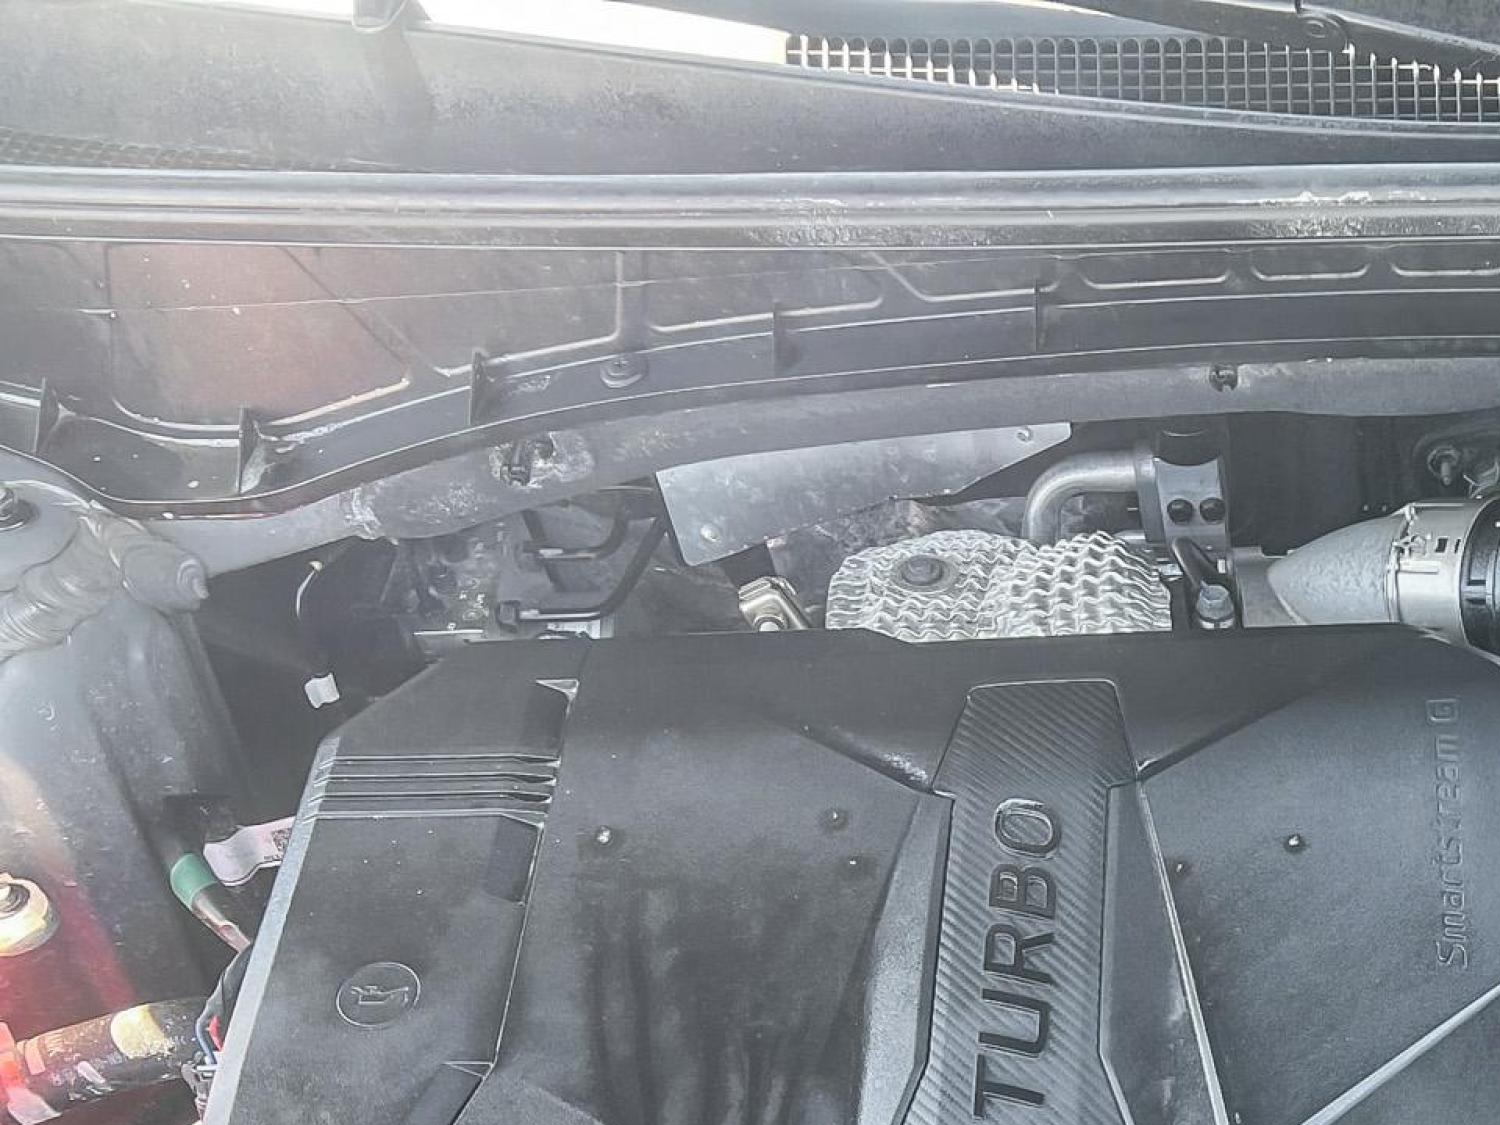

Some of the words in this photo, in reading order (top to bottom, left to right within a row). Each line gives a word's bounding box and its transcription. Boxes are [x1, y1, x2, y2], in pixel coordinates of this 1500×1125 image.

[1425, 697, 1461, 723] G
[972, 798, 1062, 1121] TURBO
[1430, 735, 1469, 970] Smartstream
